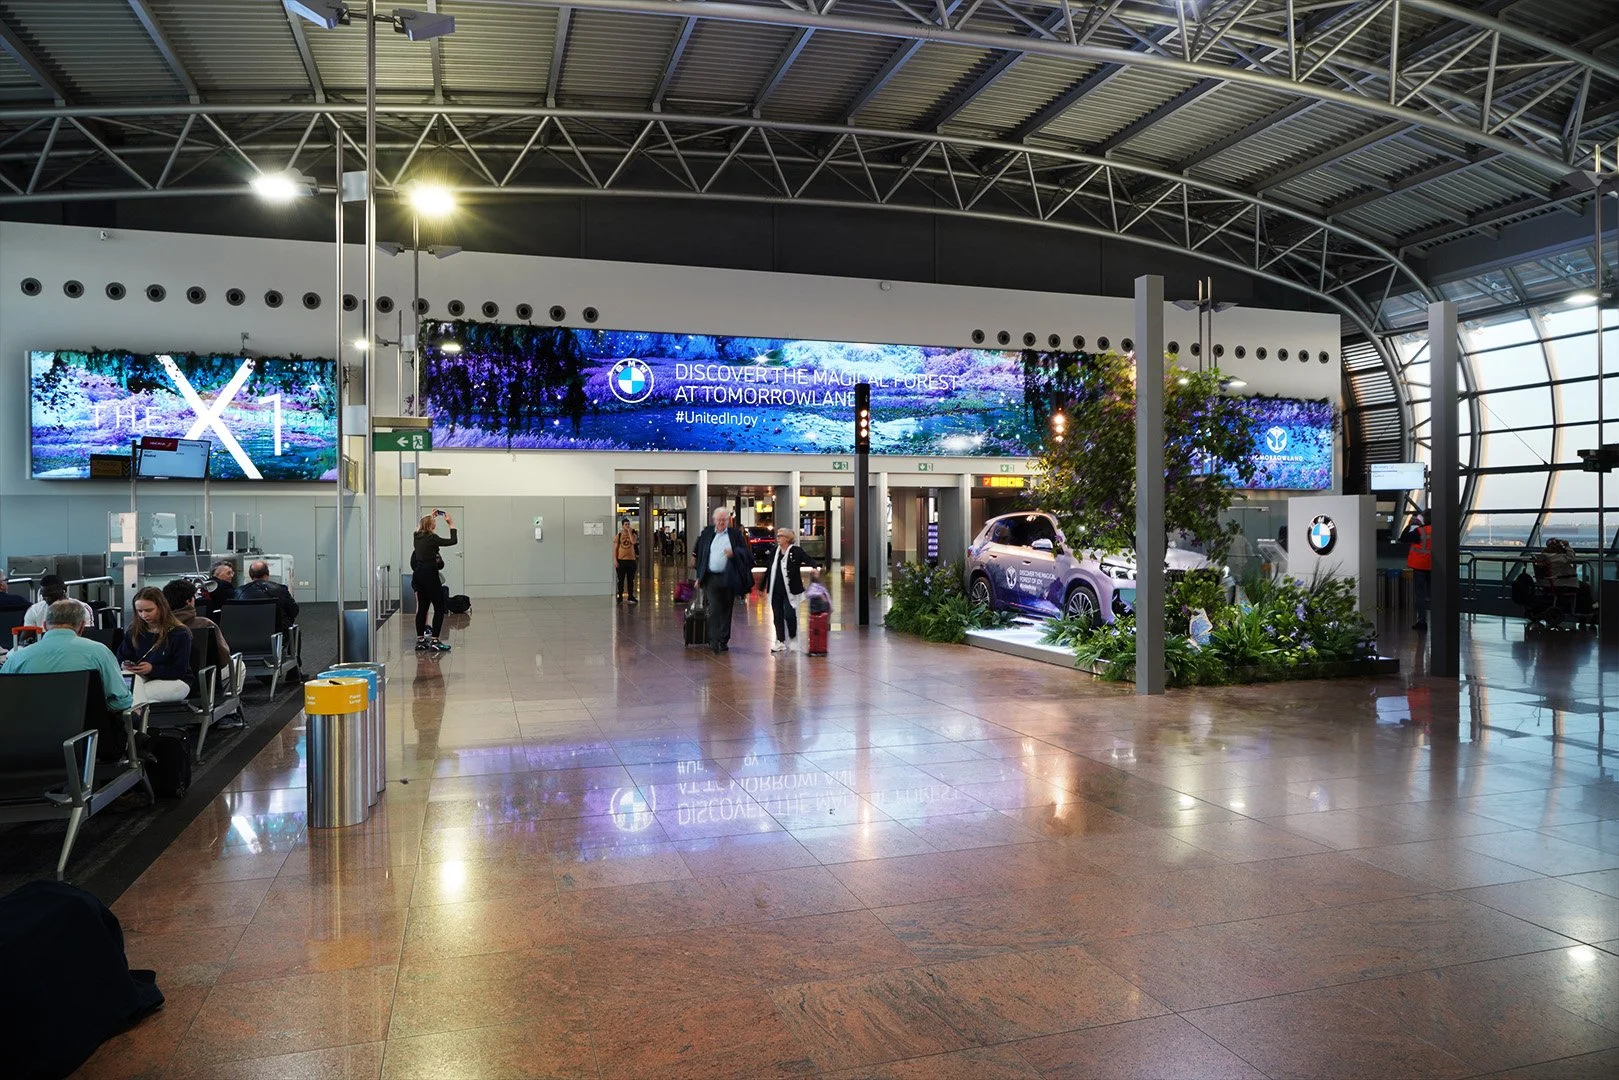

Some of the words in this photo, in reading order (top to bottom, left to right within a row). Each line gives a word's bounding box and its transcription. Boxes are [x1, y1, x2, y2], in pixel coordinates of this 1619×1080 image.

[675, 363, 768, 383] DISCOVER
[773, 367, 809, 385] THE
[894, 373, 960, 390] FOREST
[675, 385, 698, 402] AT
[87, 405, 165, 430] THE
[675, 411, 758, 428] #UnitedInJoy
